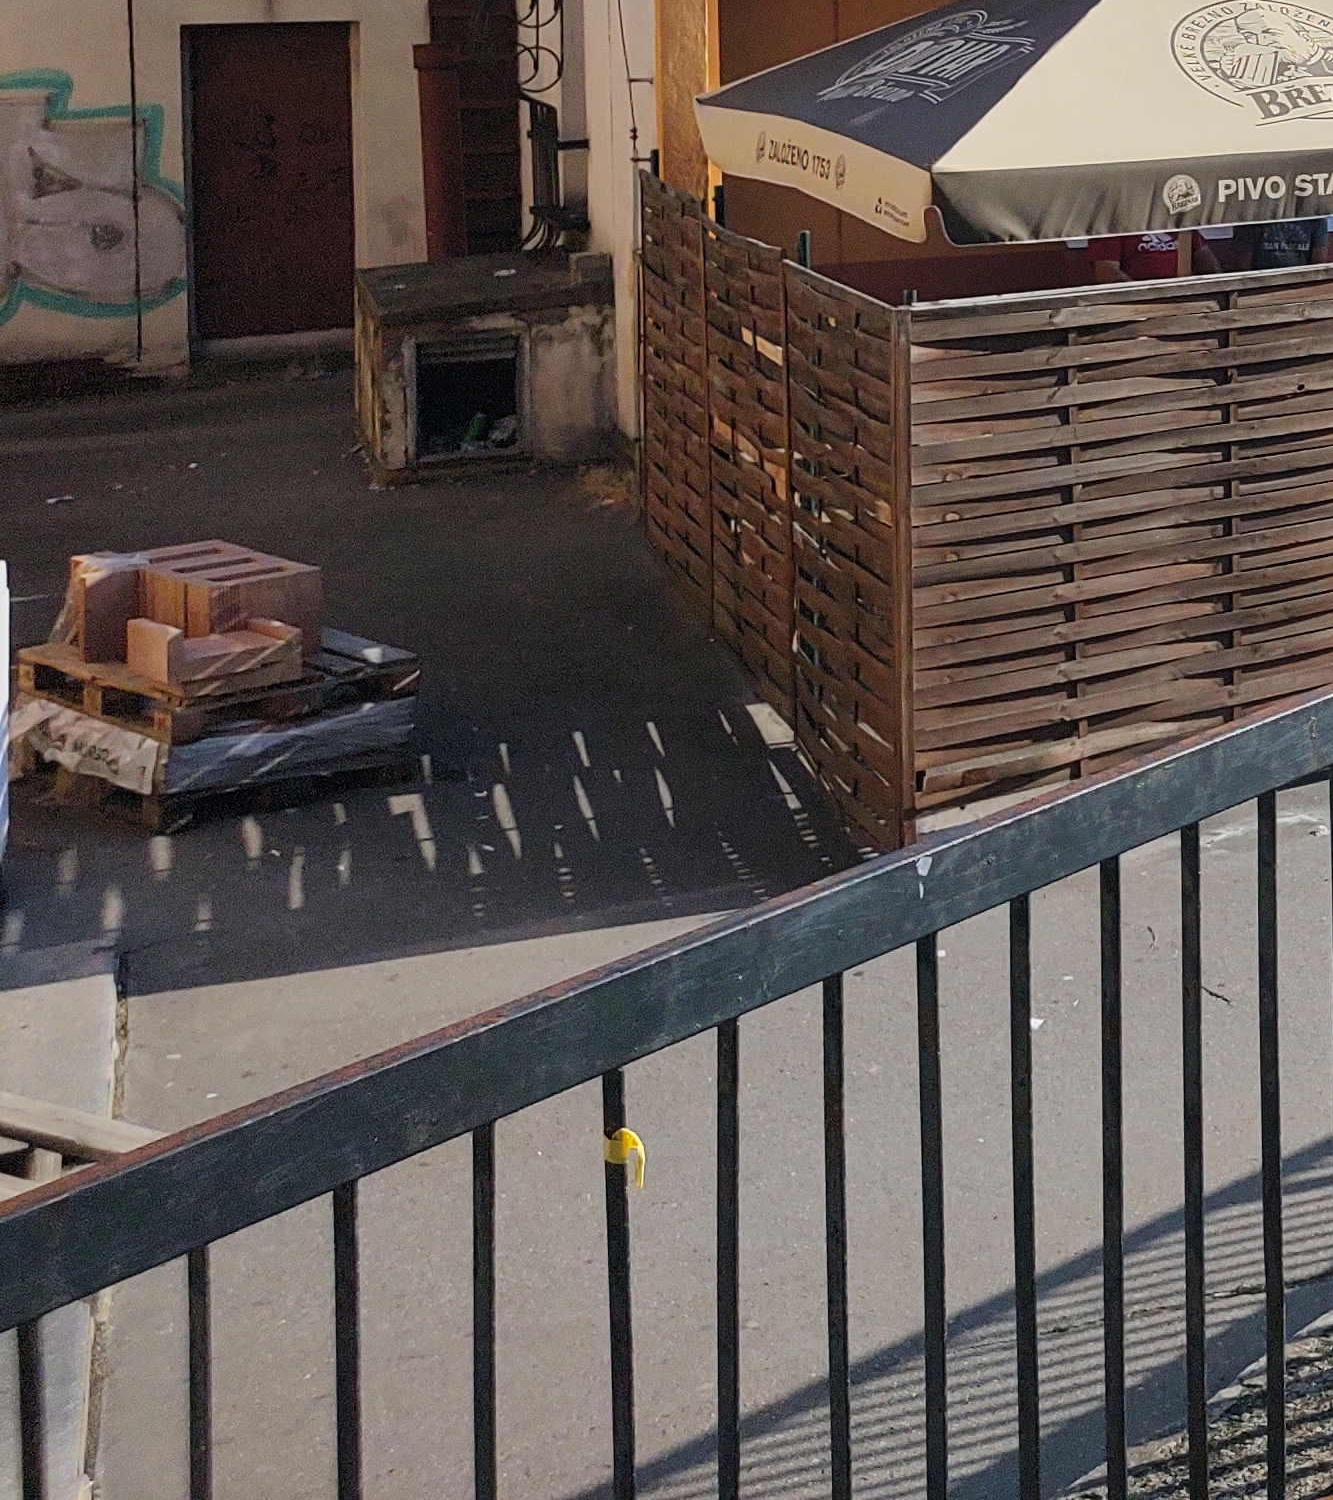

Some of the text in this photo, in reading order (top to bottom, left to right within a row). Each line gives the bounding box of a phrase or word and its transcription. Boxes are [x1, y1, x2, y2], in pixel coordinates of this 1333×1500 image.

[1182, 5, 1234, 41] BŘEZNO
[1179, 44, 1212, 82] VELKÉ
[769, 138, 831, 180] ZALOŽENO 1753
[1218, 175, 1286, 203] PIVO
